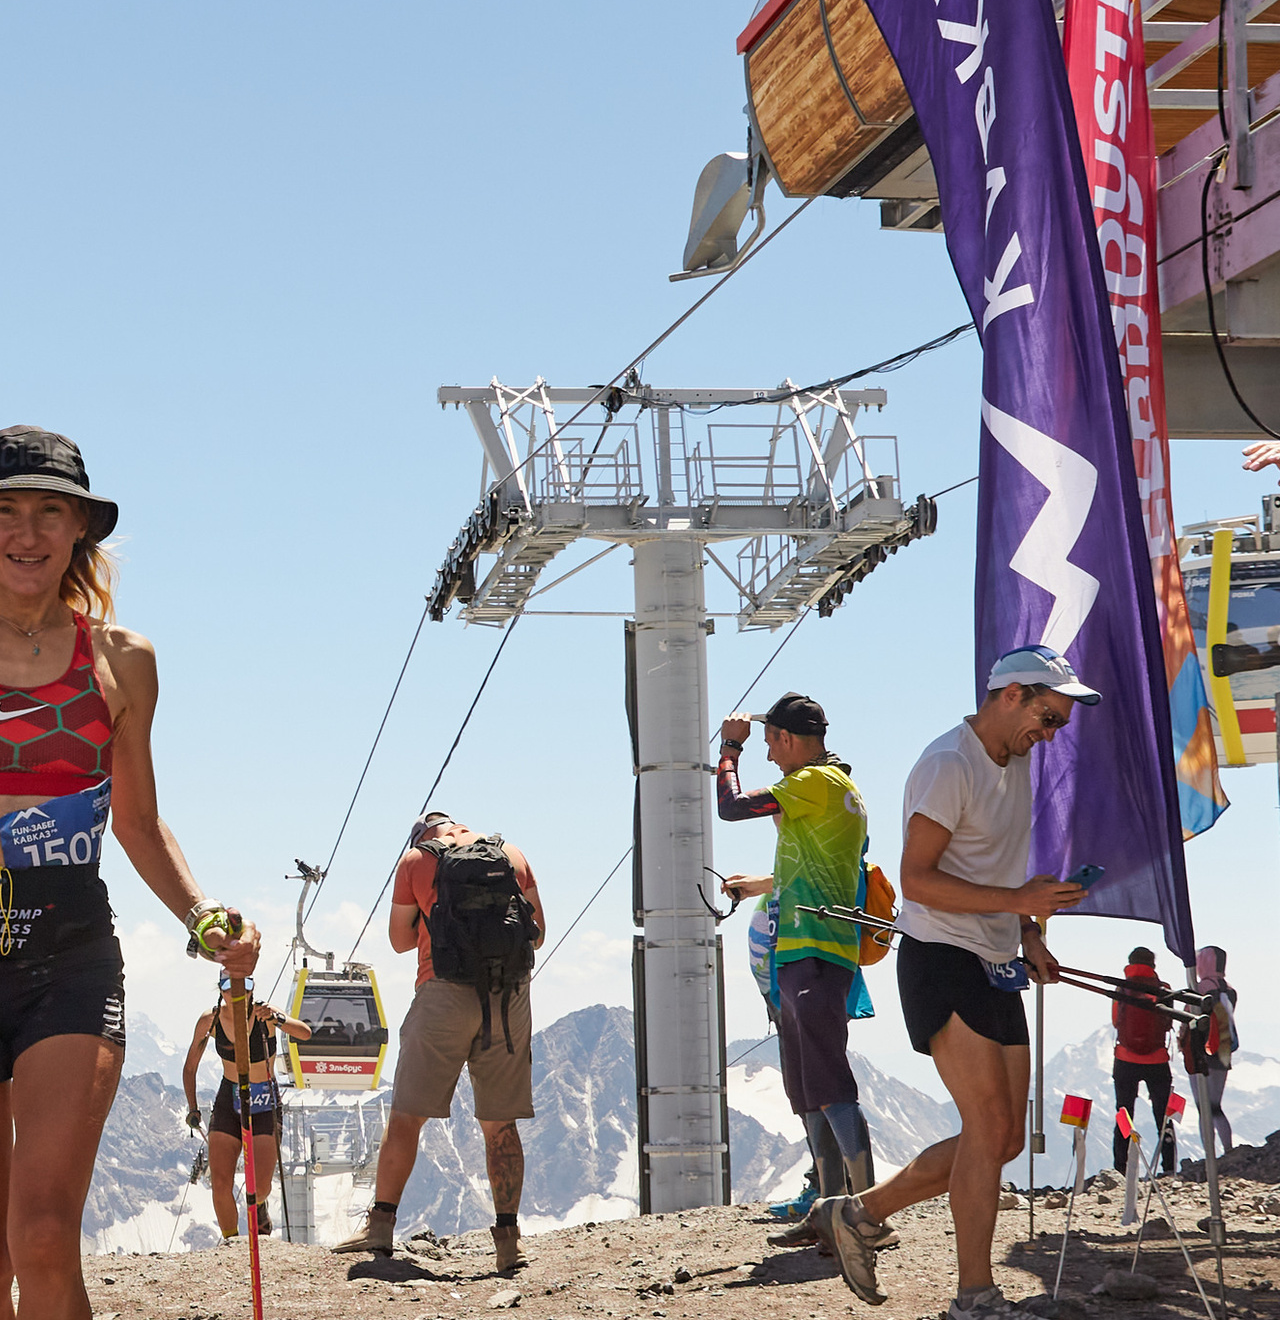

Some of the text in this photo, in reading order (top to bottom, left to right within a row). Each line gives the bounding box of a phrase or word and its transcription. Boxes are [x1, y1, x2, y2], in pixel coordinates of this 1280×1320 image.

[11, 819, 56, 836] FUN-ЗАБЕГ
[13, 830, 52, 846] КАВКАЗ
[328, 1064, 363, 1073] Эльбрус
[249, 1093, 271, 1107] 47
